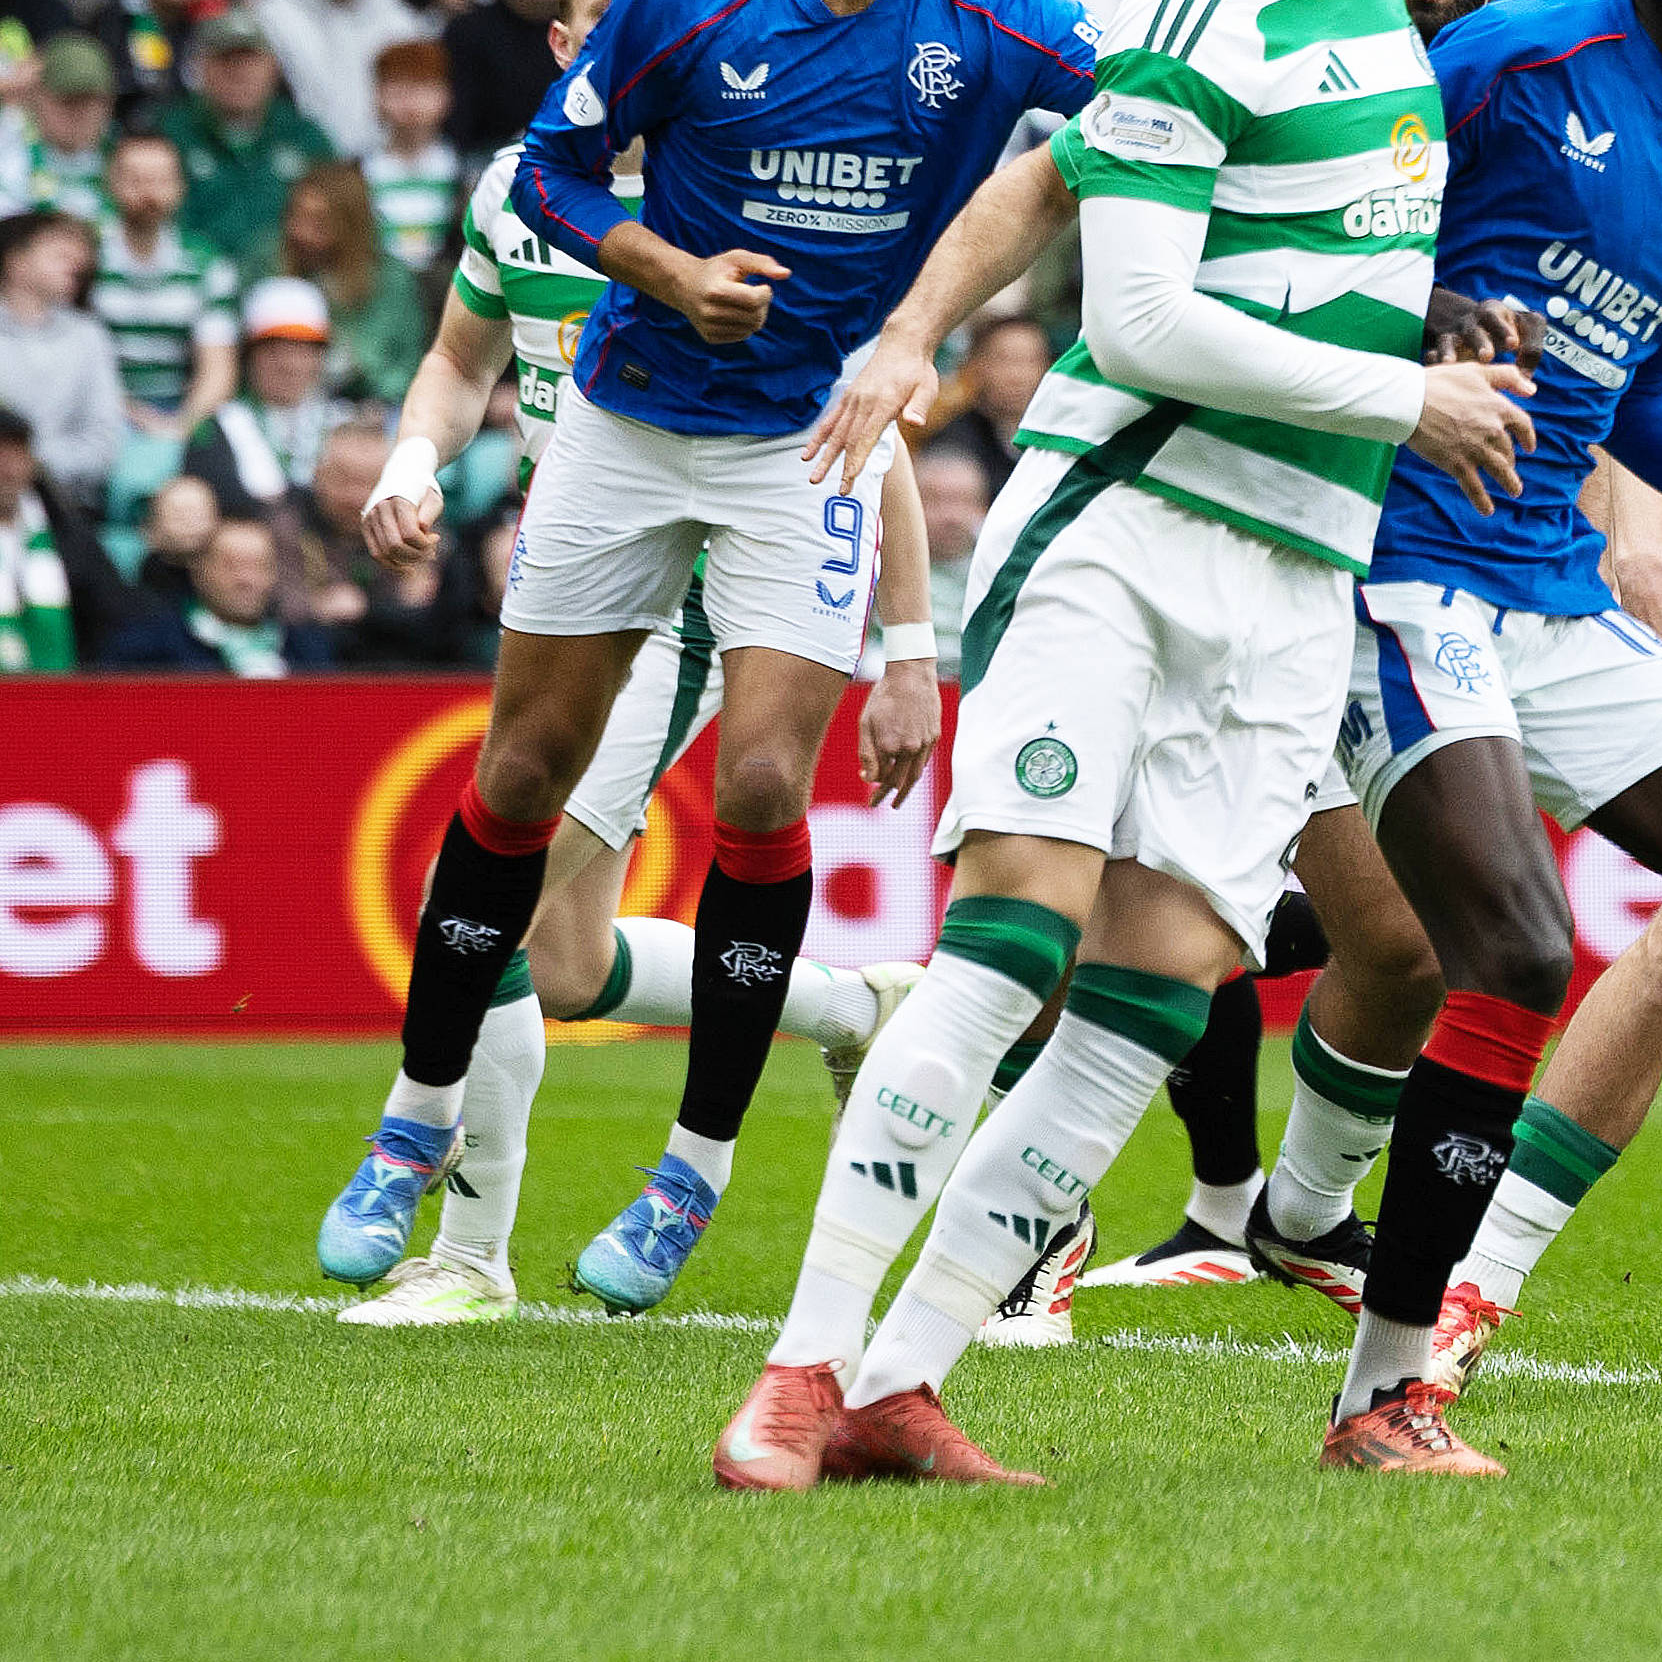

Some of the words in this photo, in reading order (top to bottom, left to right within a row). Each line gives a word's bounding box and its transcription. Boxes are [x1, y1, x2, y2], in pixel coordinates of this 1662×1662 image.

[750, 149, 923, 189] UNIBET
[766, 208, 821, 226] ZERO%
[826, 216, 891, 232] MISSION
[821, 495, 863, 576] 9
[1020, 1146, 1090, 1202] CELTI
